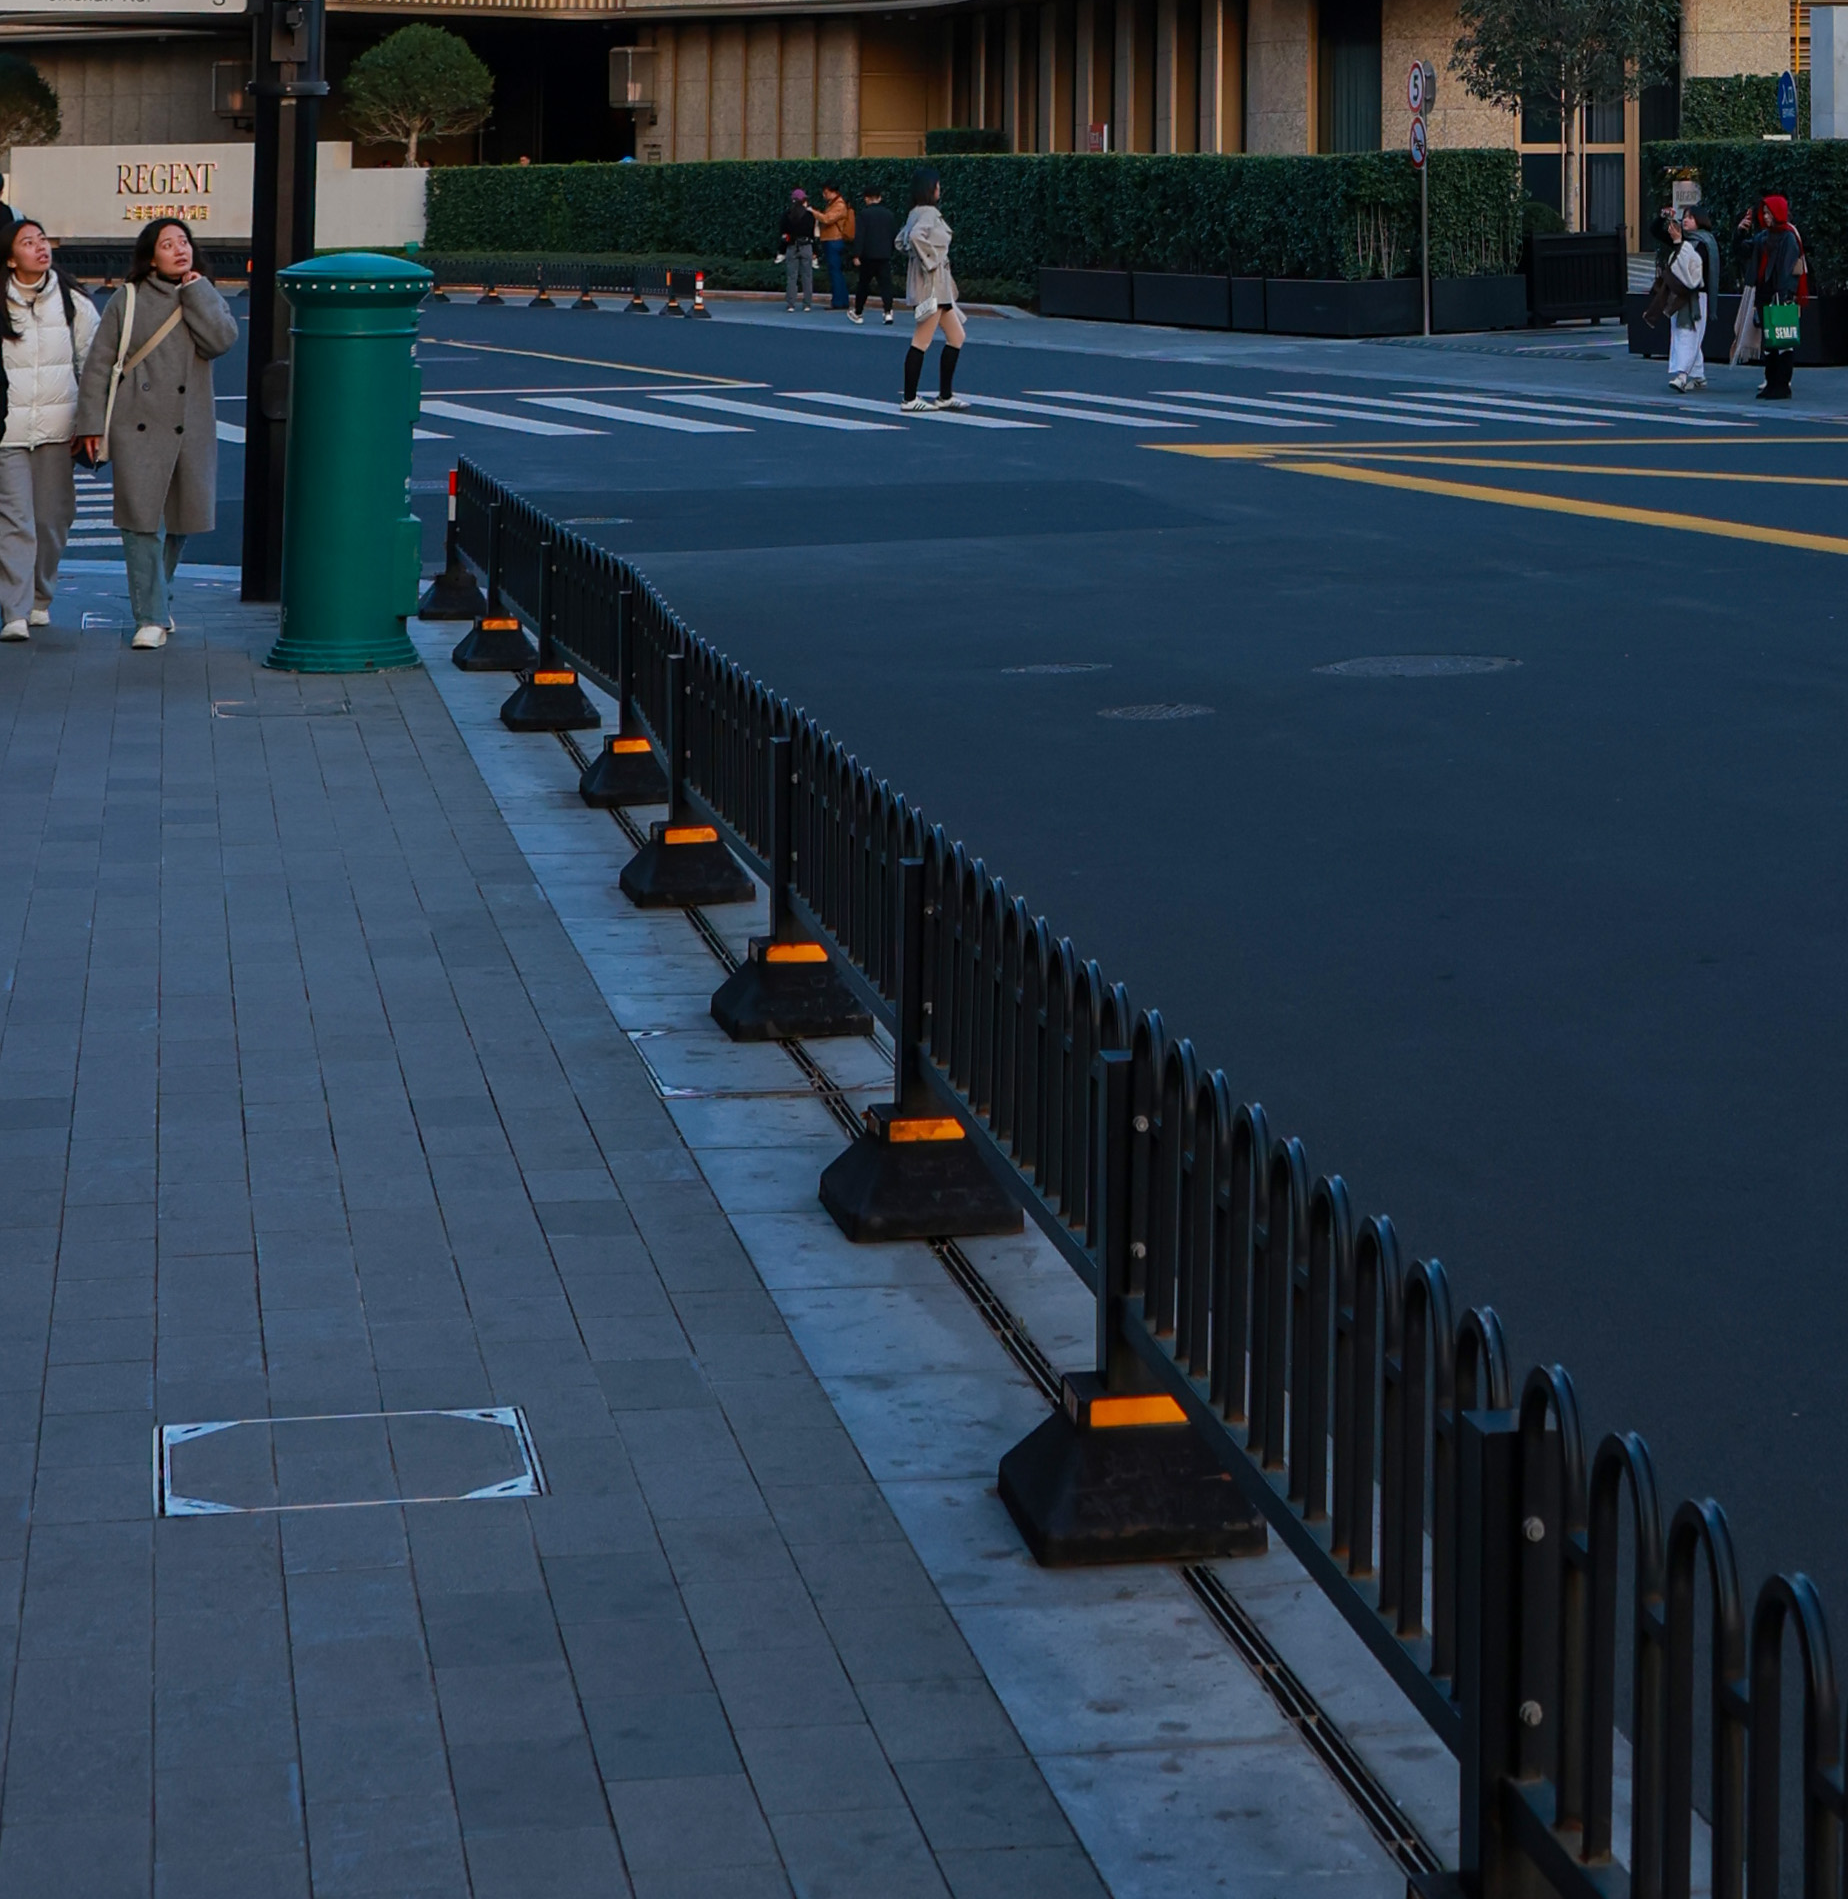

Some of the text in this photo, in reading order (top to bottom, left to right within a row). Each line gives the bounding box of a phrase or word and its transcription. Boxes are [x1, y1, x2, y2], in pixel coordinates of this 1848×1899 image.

[1413, 74, 1420, 102] 5
[1781, 84, 1794, 105] 入口
[116, 163, 217, 195] REGENT
